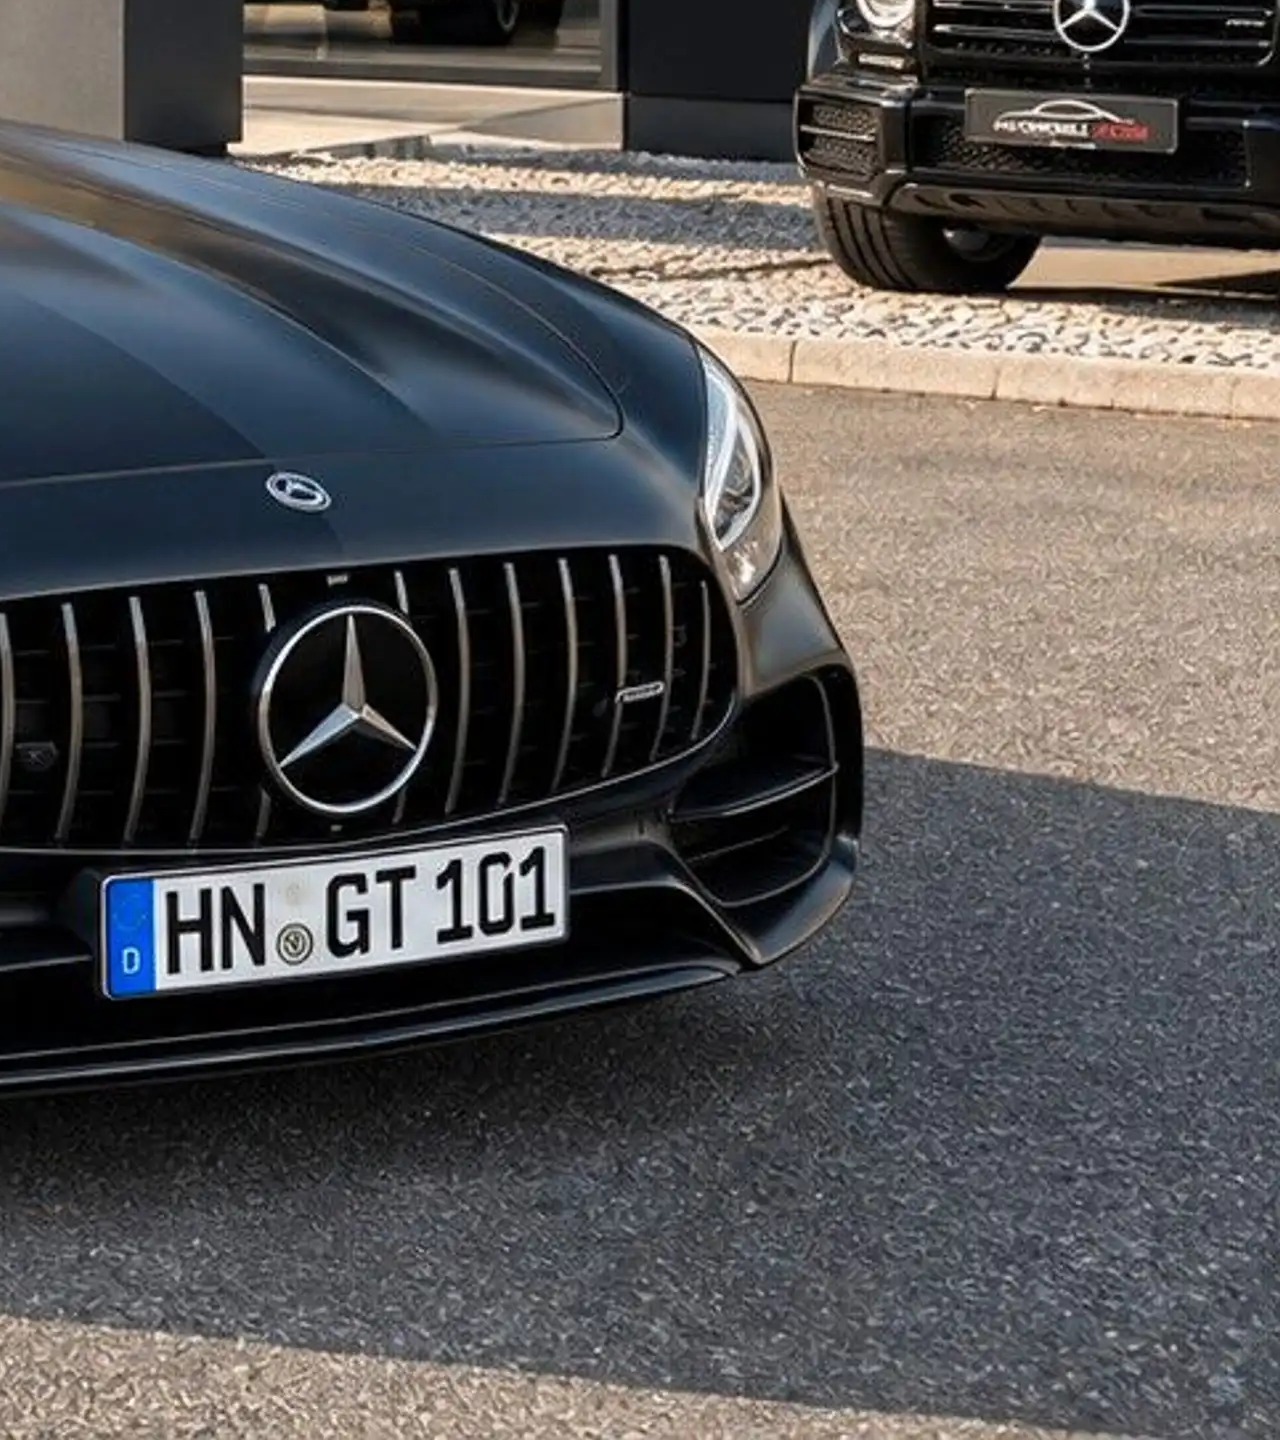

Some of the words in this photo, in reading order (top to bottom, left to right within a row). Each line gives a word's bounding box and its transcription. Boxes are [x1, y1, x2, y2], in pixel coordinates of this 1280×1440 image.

[164, 882, 267, 975] HN
[326, 866, 417, 959] GT
[434, 845, 556, 945] 101
[123, 948, 140, 973] D
